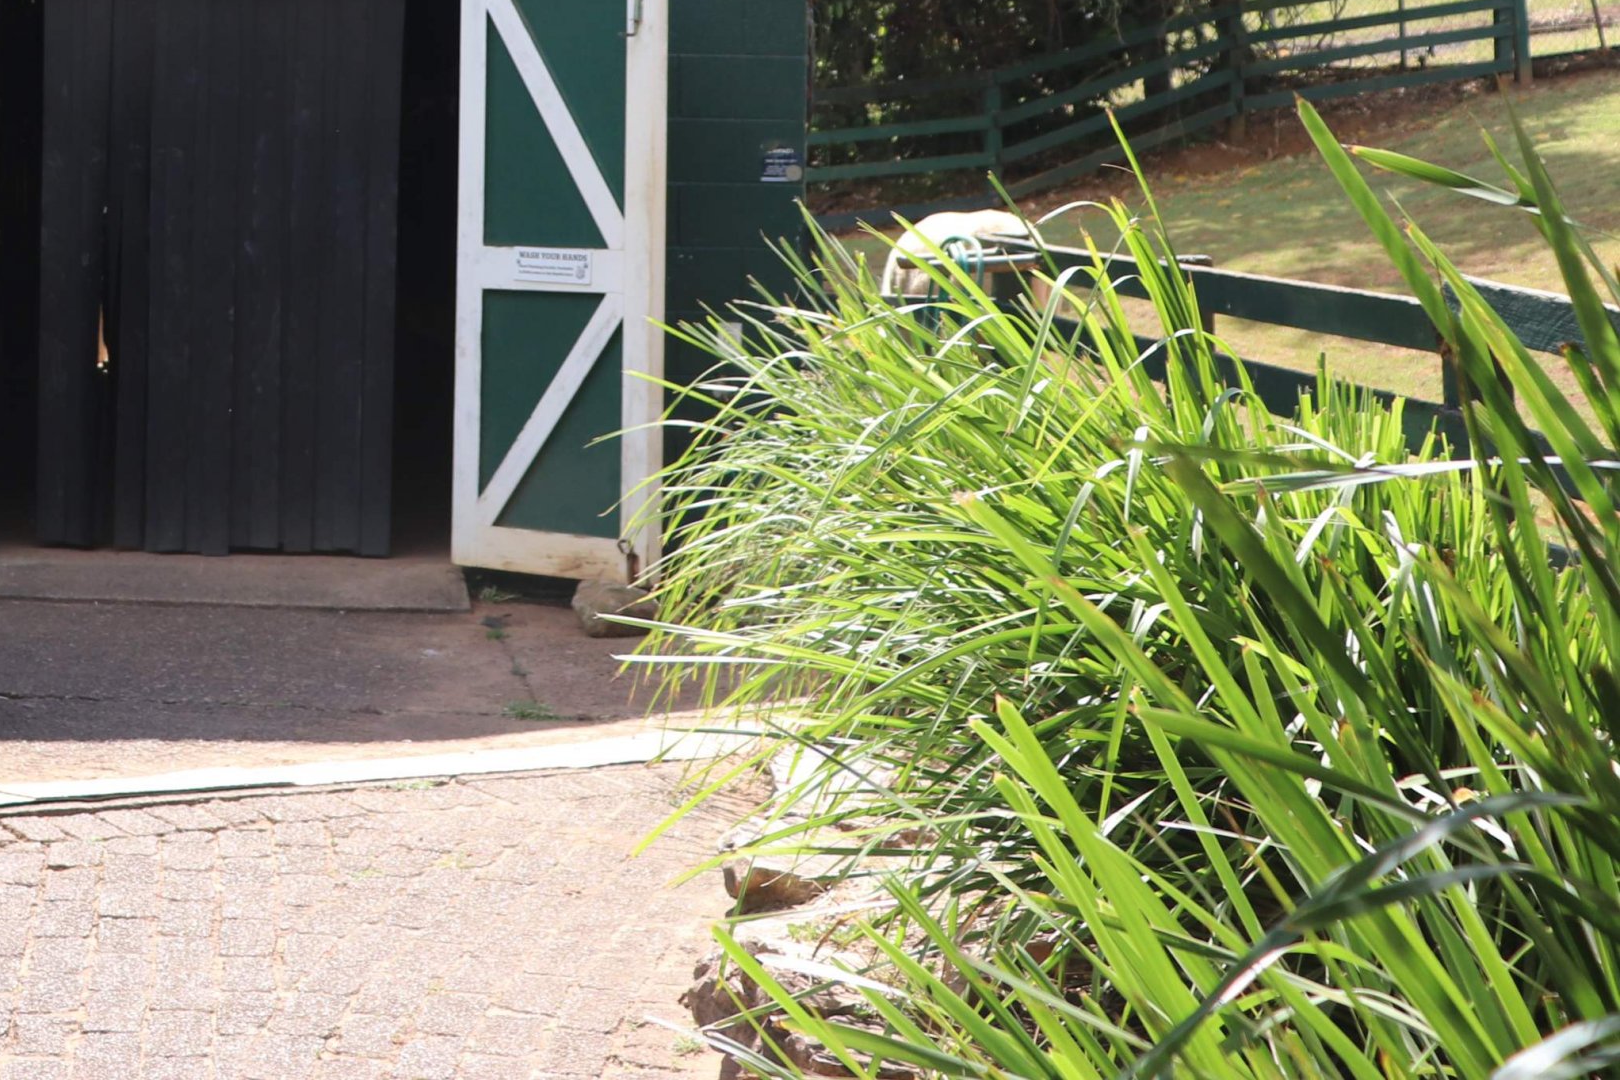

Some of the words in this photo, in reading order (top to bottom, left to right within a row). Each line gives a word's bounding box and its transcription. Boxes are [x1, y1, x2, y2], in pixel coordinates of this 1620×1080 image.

[519, 251, 540, 259] WASH
[541, 253, 560, 261] YOUR
[562, 254, 588, 262] HANDS
